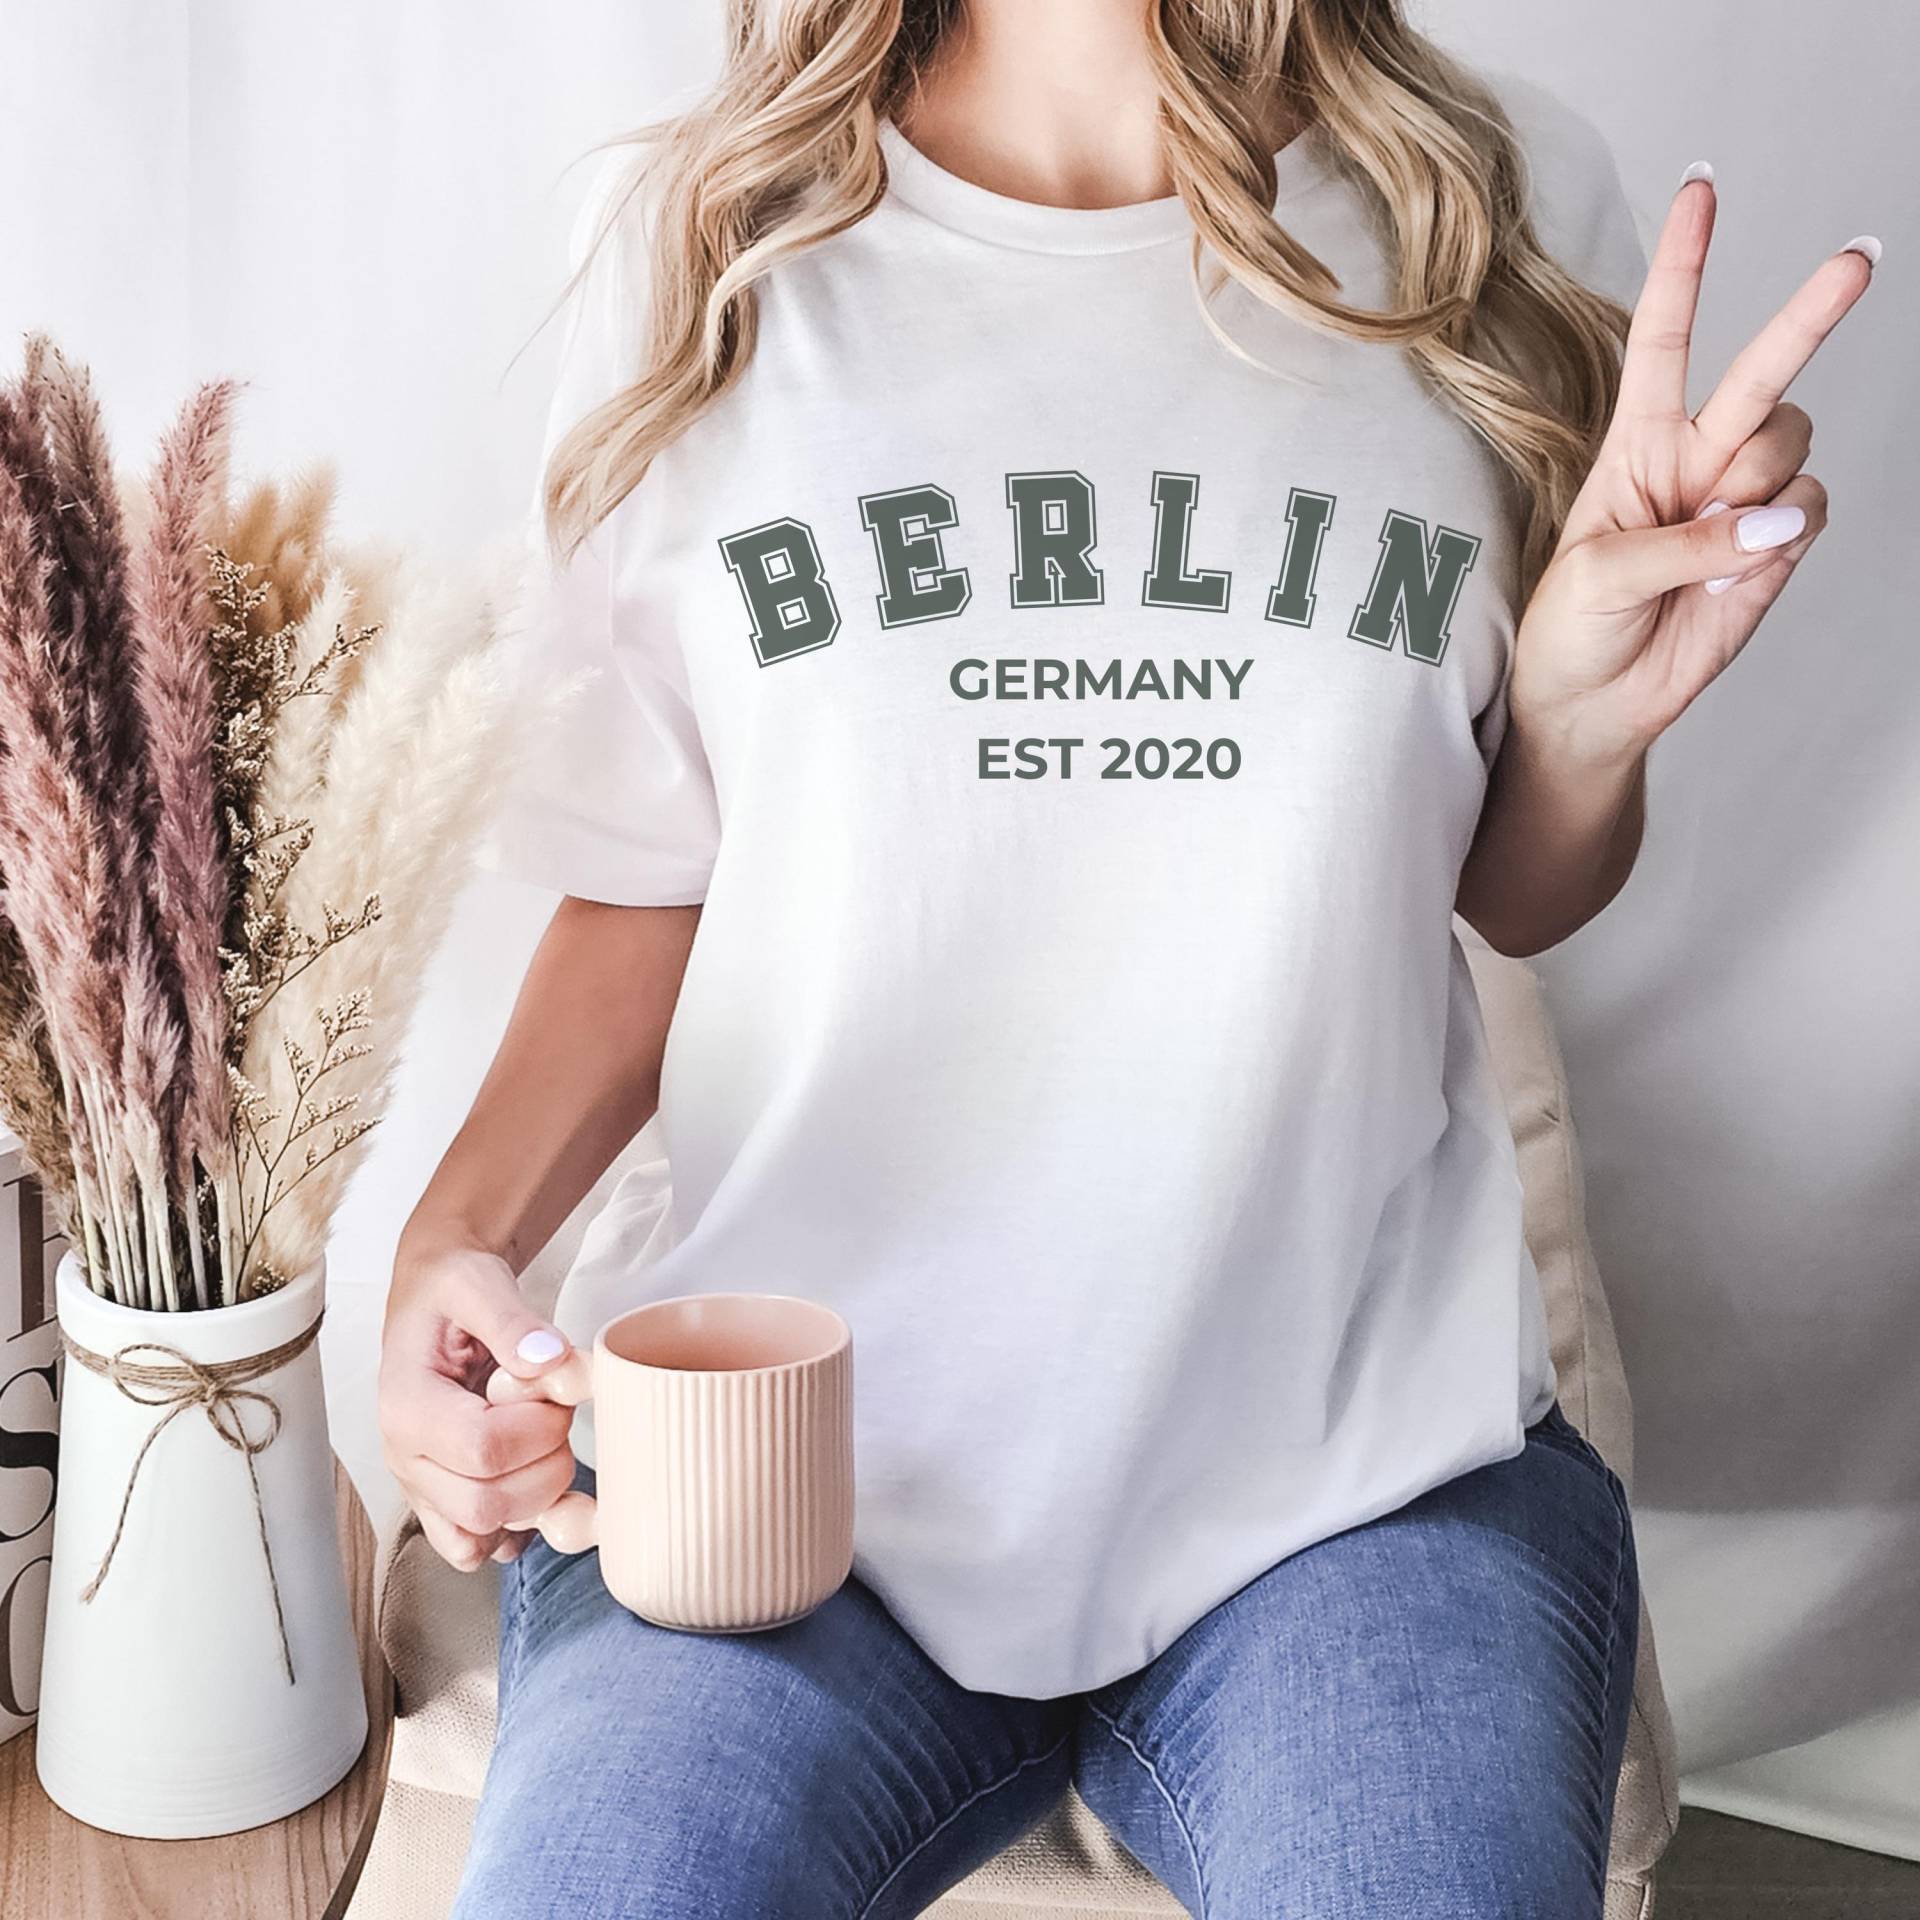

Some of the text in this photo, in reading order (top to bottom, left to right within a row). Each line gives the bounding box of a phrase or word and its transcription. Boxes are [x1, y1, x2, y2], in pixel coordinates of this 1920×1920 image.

[718, 471, 1483, 668] BERLIN
[949, 658, 1255, 701] GERMANY
[978, 737, 1242, 780] EST 2020
